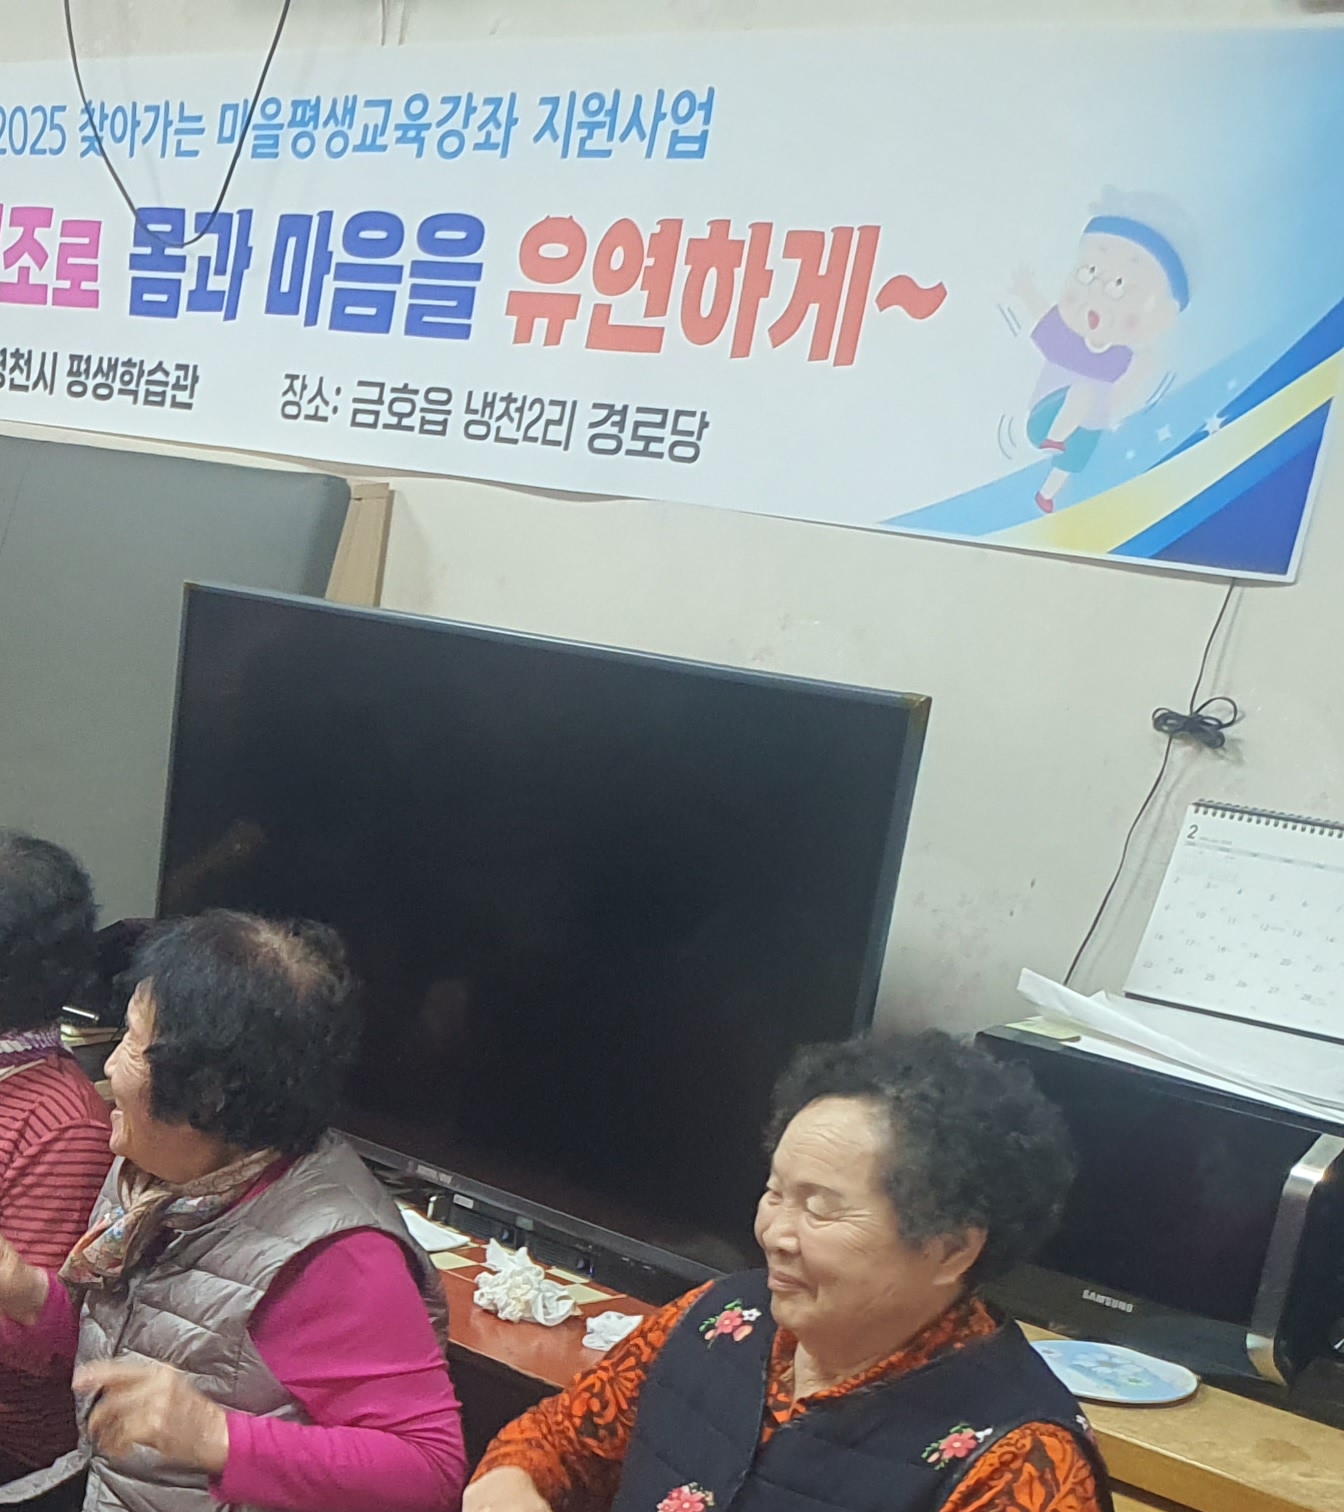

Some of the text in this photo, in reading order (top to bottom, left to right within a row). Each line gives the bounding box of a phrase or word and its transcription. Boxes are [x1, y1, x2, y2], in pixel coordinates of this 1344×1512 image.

[78, 99, 206, 160] 찾아가는
[216, 92, 519, 160] 마을평생교육강좌
[532, 86, 715, 160] 지원사업
[128, 206, 254, 322] 몸과
[263, 210, 485, 341] 마음을
[505, 214, 948, 367] 유연하게~
[65, 353, 200, 411] 평생학습관
[279, 373, 710, 464] 장소: 금호읍 냉천2리 경로당
[1186, 824, 1199, 840] 2
